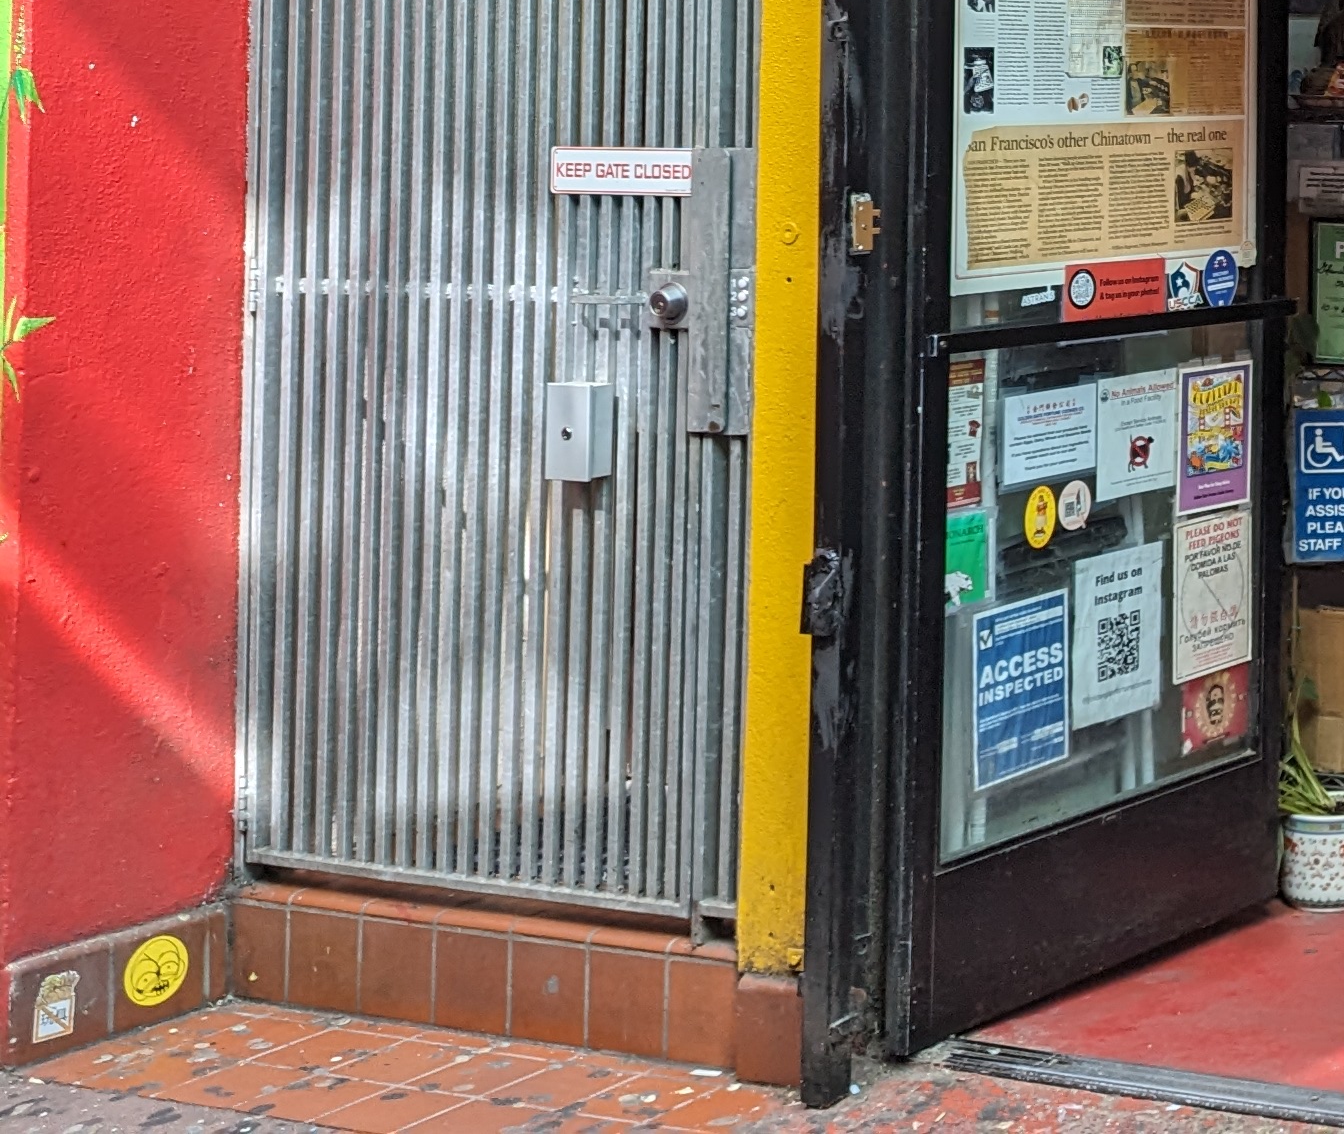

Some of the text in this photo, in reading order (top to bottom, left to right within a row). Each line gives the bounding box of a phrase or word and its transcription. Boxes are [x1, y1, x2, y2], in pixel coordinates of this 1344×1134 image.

[990, 134, 1055, 153] Francisco's
[1057, 131, 1089, 149] other
[1091, 129, 1151, 147] Chinatown
[1166, 127, 1184, 144] the
[1187, 126, 1206, 142] real
[1208, 129, 1228, 142] one
[555, 162, 692, 180] KEEP GATE CLOSED
[1111, 380, 1175, 398] No Animals Allowed
[1130, 396, 1144, 405] Food
[1144, 393, 1162, 403] Facility
[1307, 487, 1322, 501] IF
[1185, 517, 1243, 541] PLEASE DO NOT
[1188, 528, 1241, 551] FEED PIGEONS
[1298, 538, 1342, 552] STAFF
[1184, 551, 1199, 563] POR
[1199, 544, 1221, 559] FAVOR
[1217, 555, 1223, 564] A
[1224, 551, 1236, 563] LAS
[1095, 567, 1143, 587] Find us on
[1094, 585, 1143, 607] Instagram
[979, 642, 1063, 689] ACCESS
[978, 666, 1064, 707] INSPECTED
